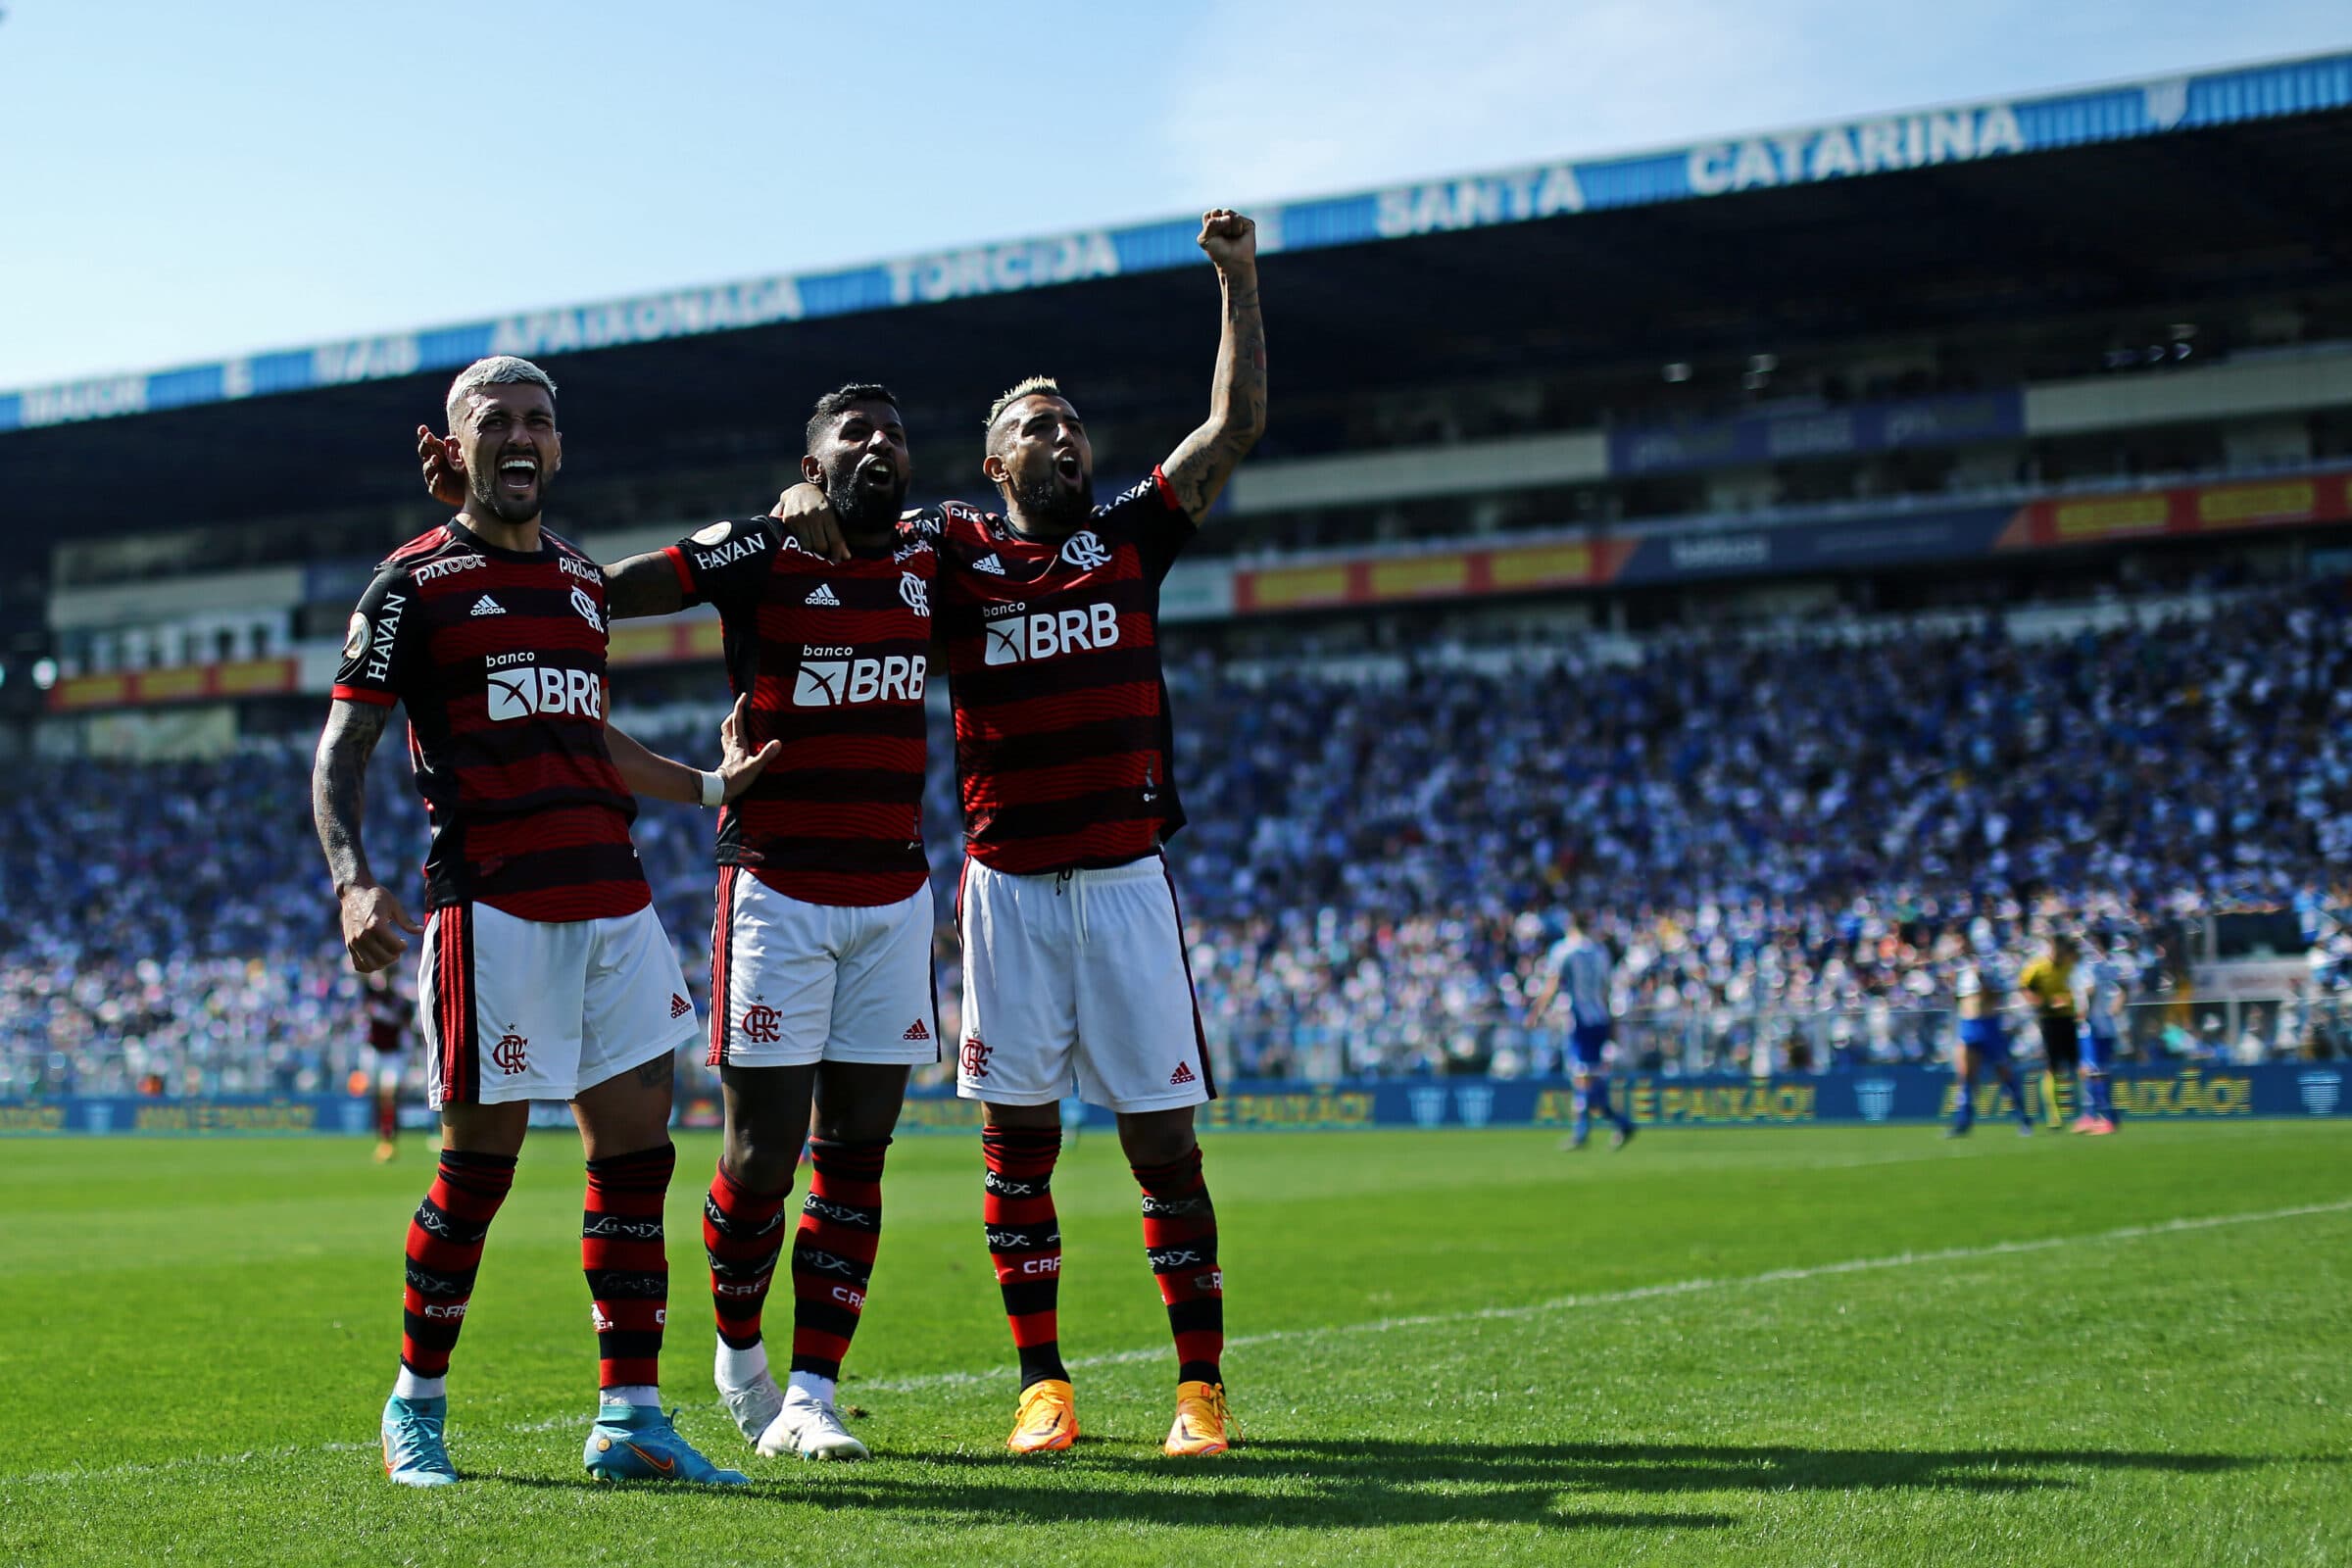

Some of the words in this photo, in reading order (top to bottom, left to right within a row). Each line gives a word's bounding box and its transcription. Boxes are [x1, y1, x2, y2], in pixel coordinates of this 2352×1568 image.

[1376, 165, 1587, 239] SANTA
[1687, 106, 2025, 195] CATARINA
[695, 532, 766, 570] HAVAN
[469, 607, 508, 616] adidas
[804, 595, 841, 607] adidas
[983, 601, 1026, 618] banco
[366, 591, 407, 683] HAVAN
[1029, 602, 1119, 660] BRB
[485, 650, 536, 668] banco
[803, 644, 854, 657] banco
[538, 666, 602, 720] BRB
[848, 655, 927, 704] BRB
